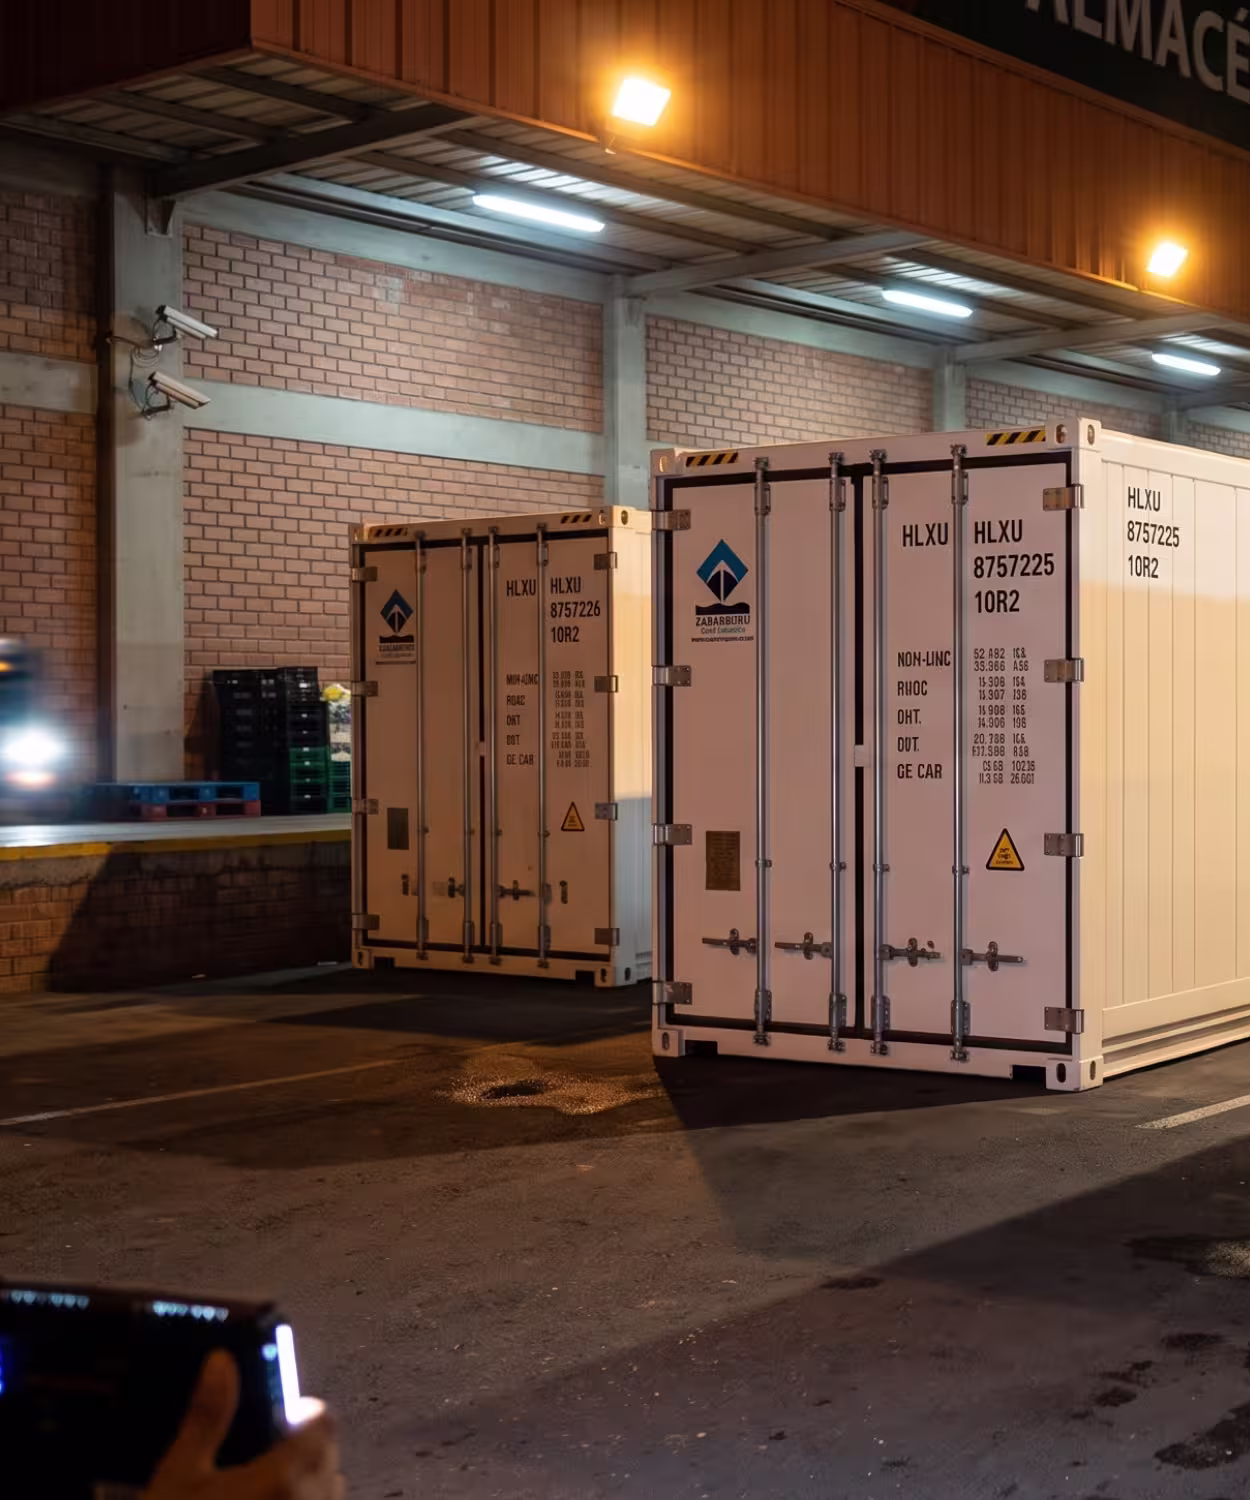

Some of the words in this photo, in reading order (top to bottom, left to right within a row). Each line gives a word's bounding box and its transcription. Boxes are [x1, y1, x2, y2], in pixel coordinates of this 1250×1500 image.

[1127, 486, 1161, 512] HLXU
[902, 522, 949, 547] HLXU
[974, 519, 1023, 544] HLXU
[1127, 520, 1180, 548] 8757225
[973, 553, 1055, 578] 8757225
[1128, 554, 1159, 579] 10R2
[506, 578, 537, 597] HLXU
[550, 576, 581, 594] HLXU
[550, 600, 601, 619] 8757226
[974, 589, 1020, 613] 10R2
[551, 626, 580, 643] 10R2
[917, 763, 943, 780] CAR
